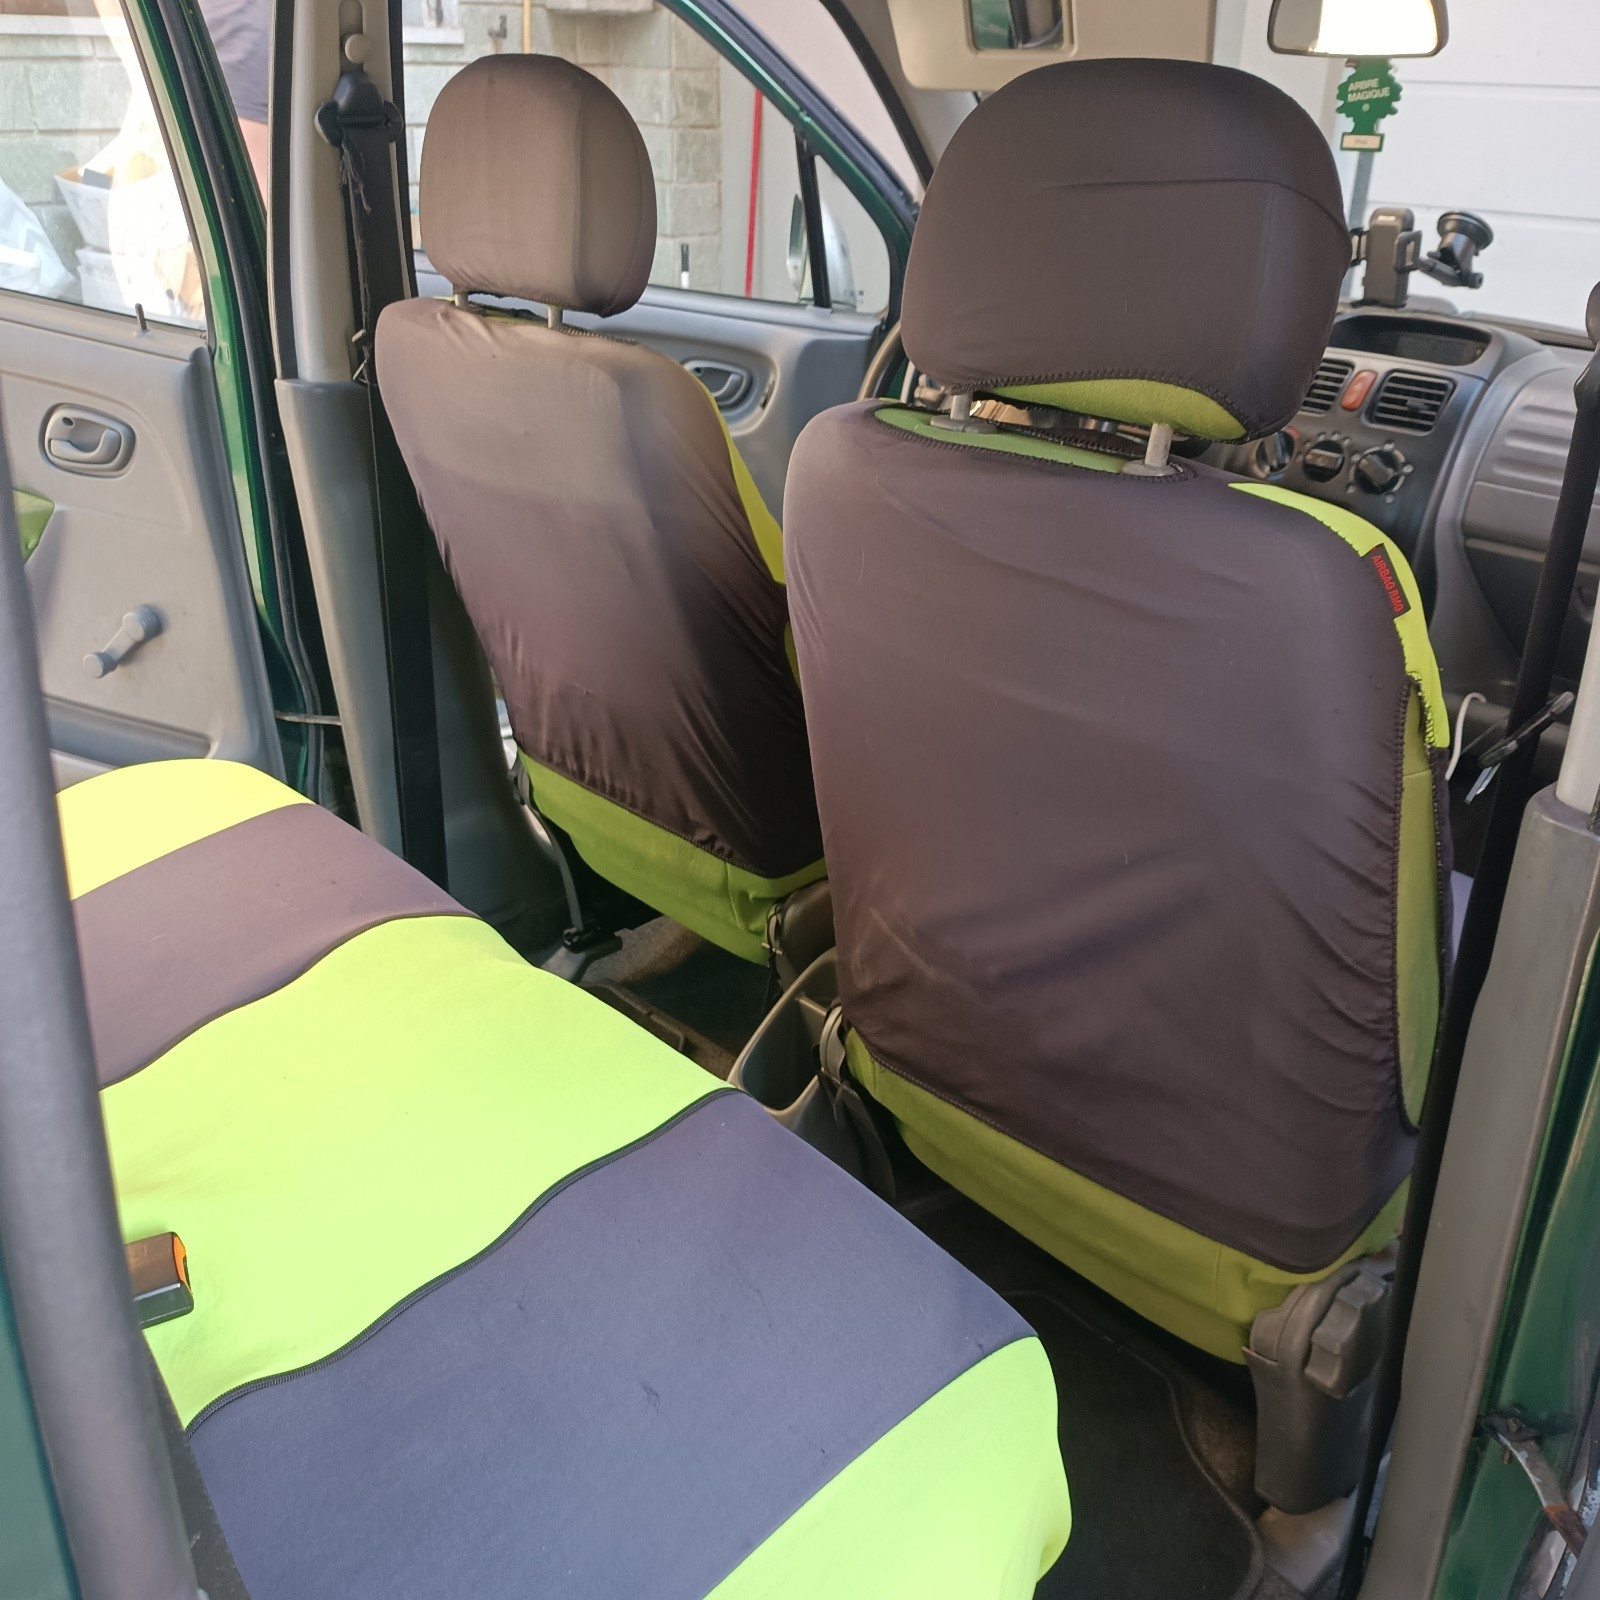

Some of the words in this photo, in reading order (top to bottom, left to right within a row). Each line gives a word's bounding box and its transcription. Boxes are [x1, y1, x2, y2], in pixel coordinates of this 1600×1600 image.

[1348, 78, 1379, 92] ARBRE
[1347, 87, 1390, 103] MAGIQUE
[1372, 555, 1395, 590] AIRBAG
